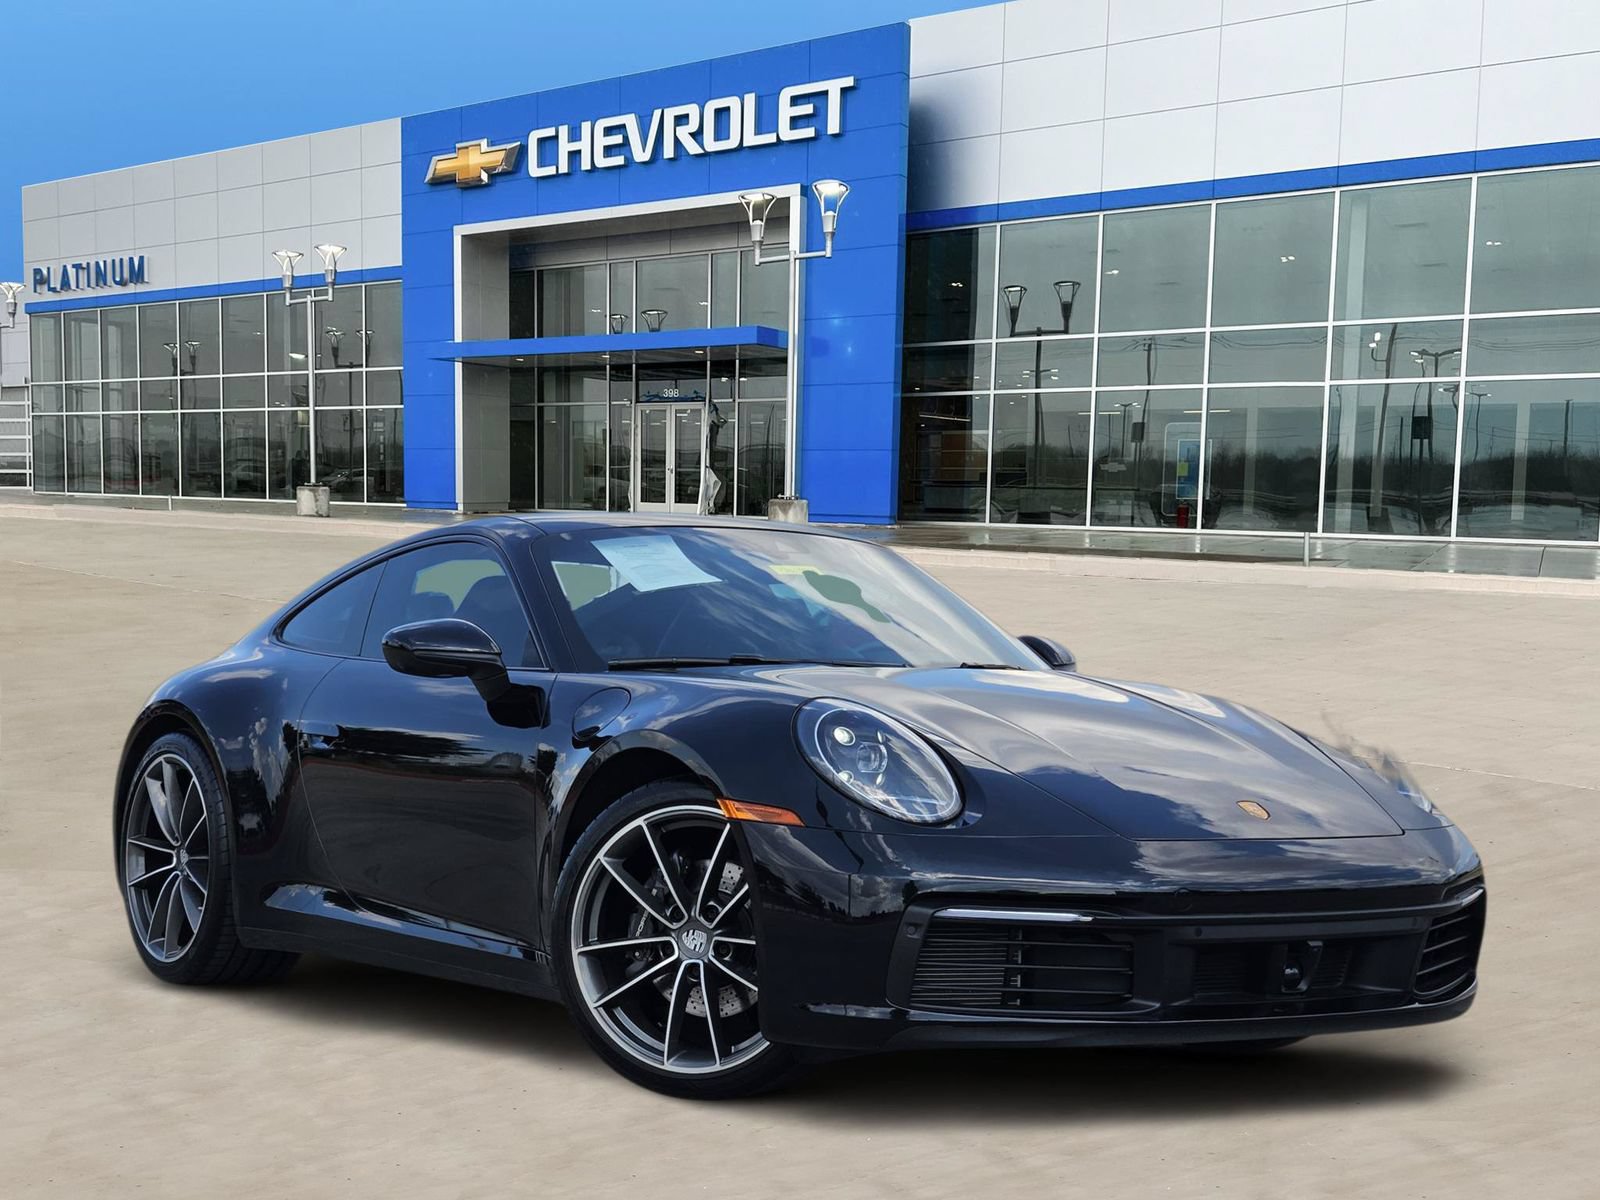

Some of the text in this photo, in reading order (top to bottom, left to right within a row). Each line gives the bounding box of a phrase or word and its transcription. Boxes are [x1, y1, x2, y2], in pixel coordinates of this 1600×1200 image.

[527, 75, 855, 178] CHEVROLET
[33, 255, 148, 294] PLATINUM
[663, 388, 679, 398] 398
